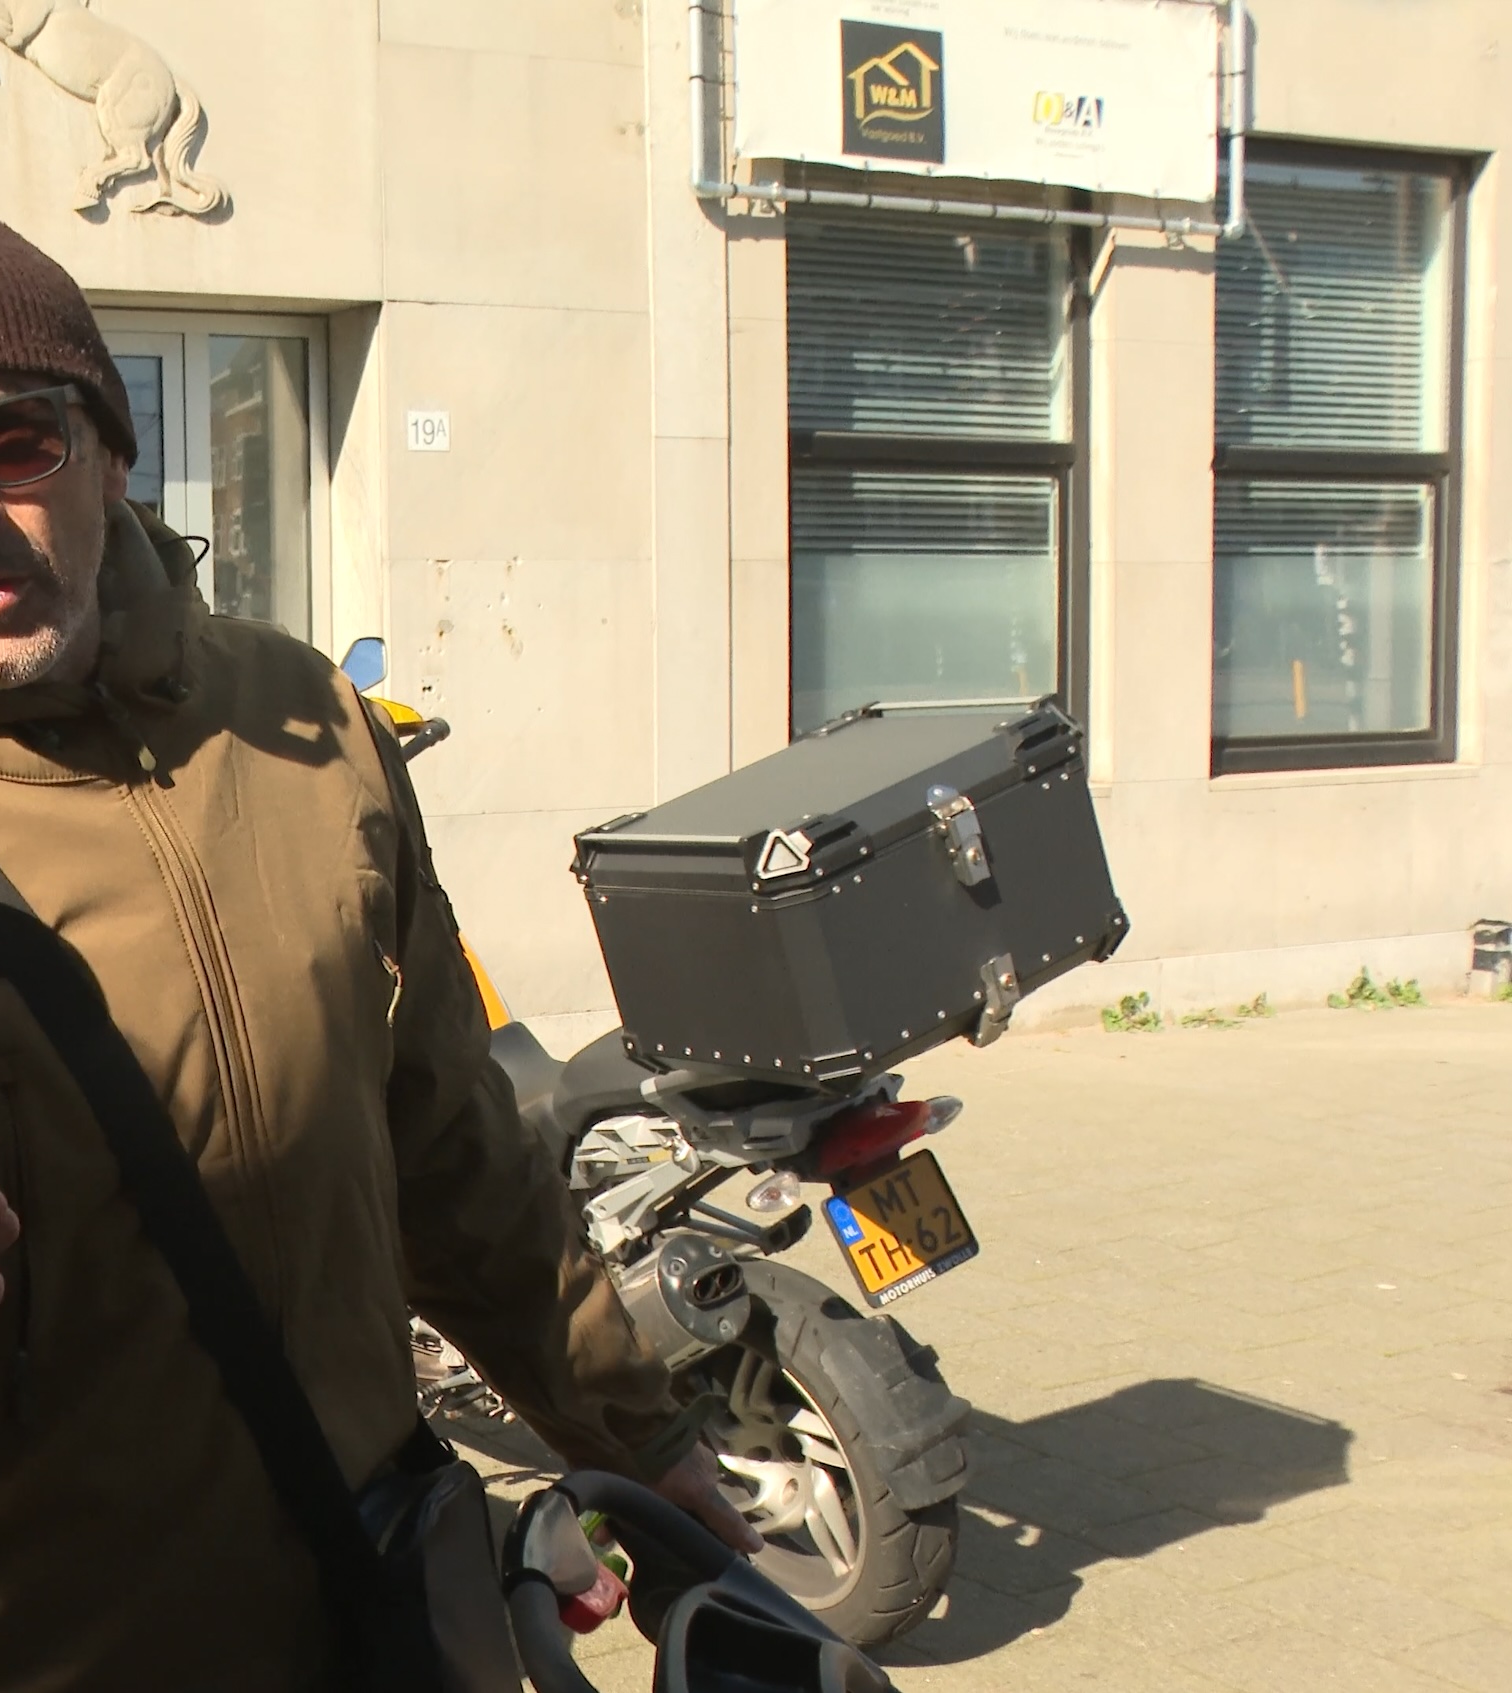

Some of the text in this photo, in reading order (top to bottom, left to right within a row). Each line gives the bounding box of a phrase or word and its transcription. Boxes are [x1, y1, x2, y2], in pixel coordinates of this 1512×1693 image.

[870, 84, 917, 109] W&M
[411, 418, 447, 446] 19A
[869, 1169, 920, 1223] MT
[842, 1225, 858, 1239] NL
[879, 1267, 937, 1305] MOTORHUIS
